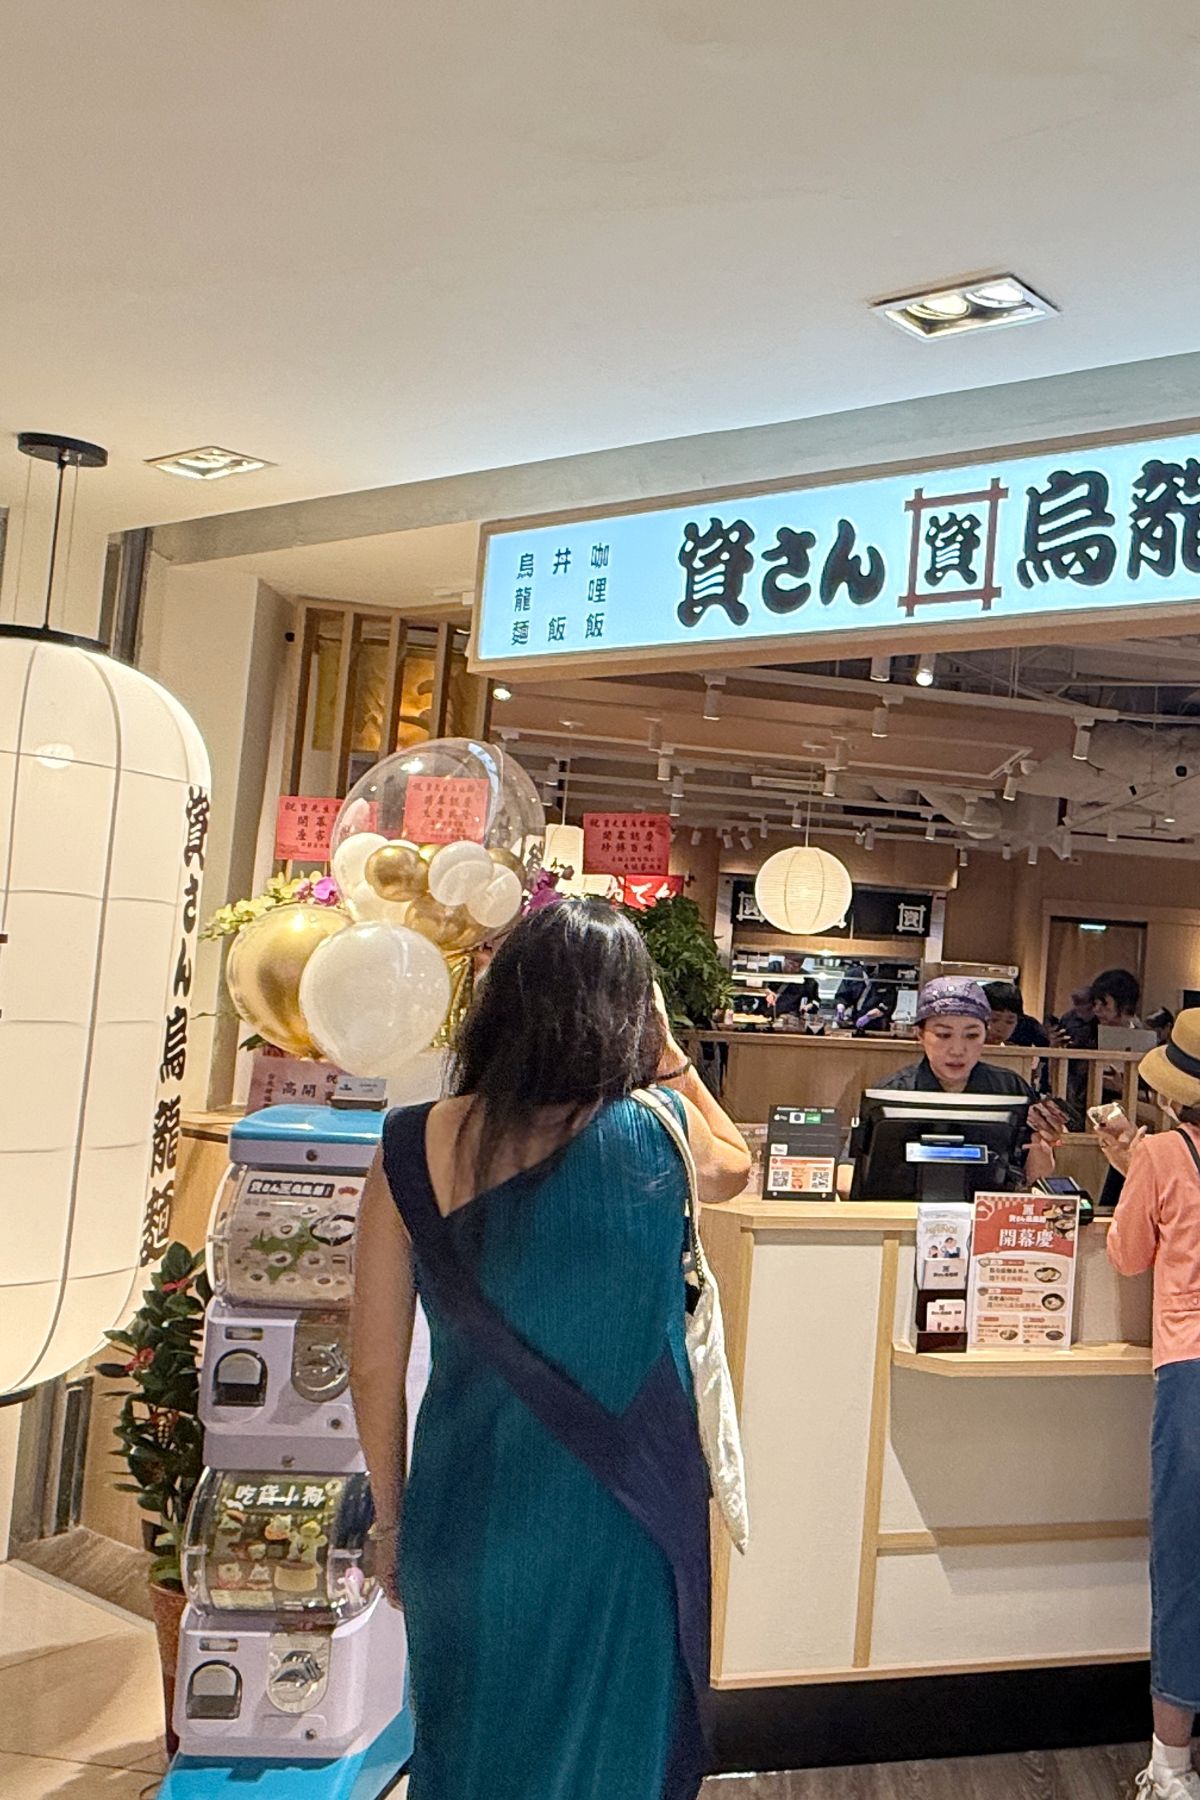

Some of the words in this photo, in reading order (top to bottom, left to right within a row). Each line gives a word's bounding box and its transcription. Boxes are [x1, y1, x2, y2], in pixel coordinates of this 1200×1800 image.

[585, 542, 610, 639] 咖哩飯
[677, 517, 886, 628] 資さん
[999, 1228, 1055, 1248] 開幕慶
